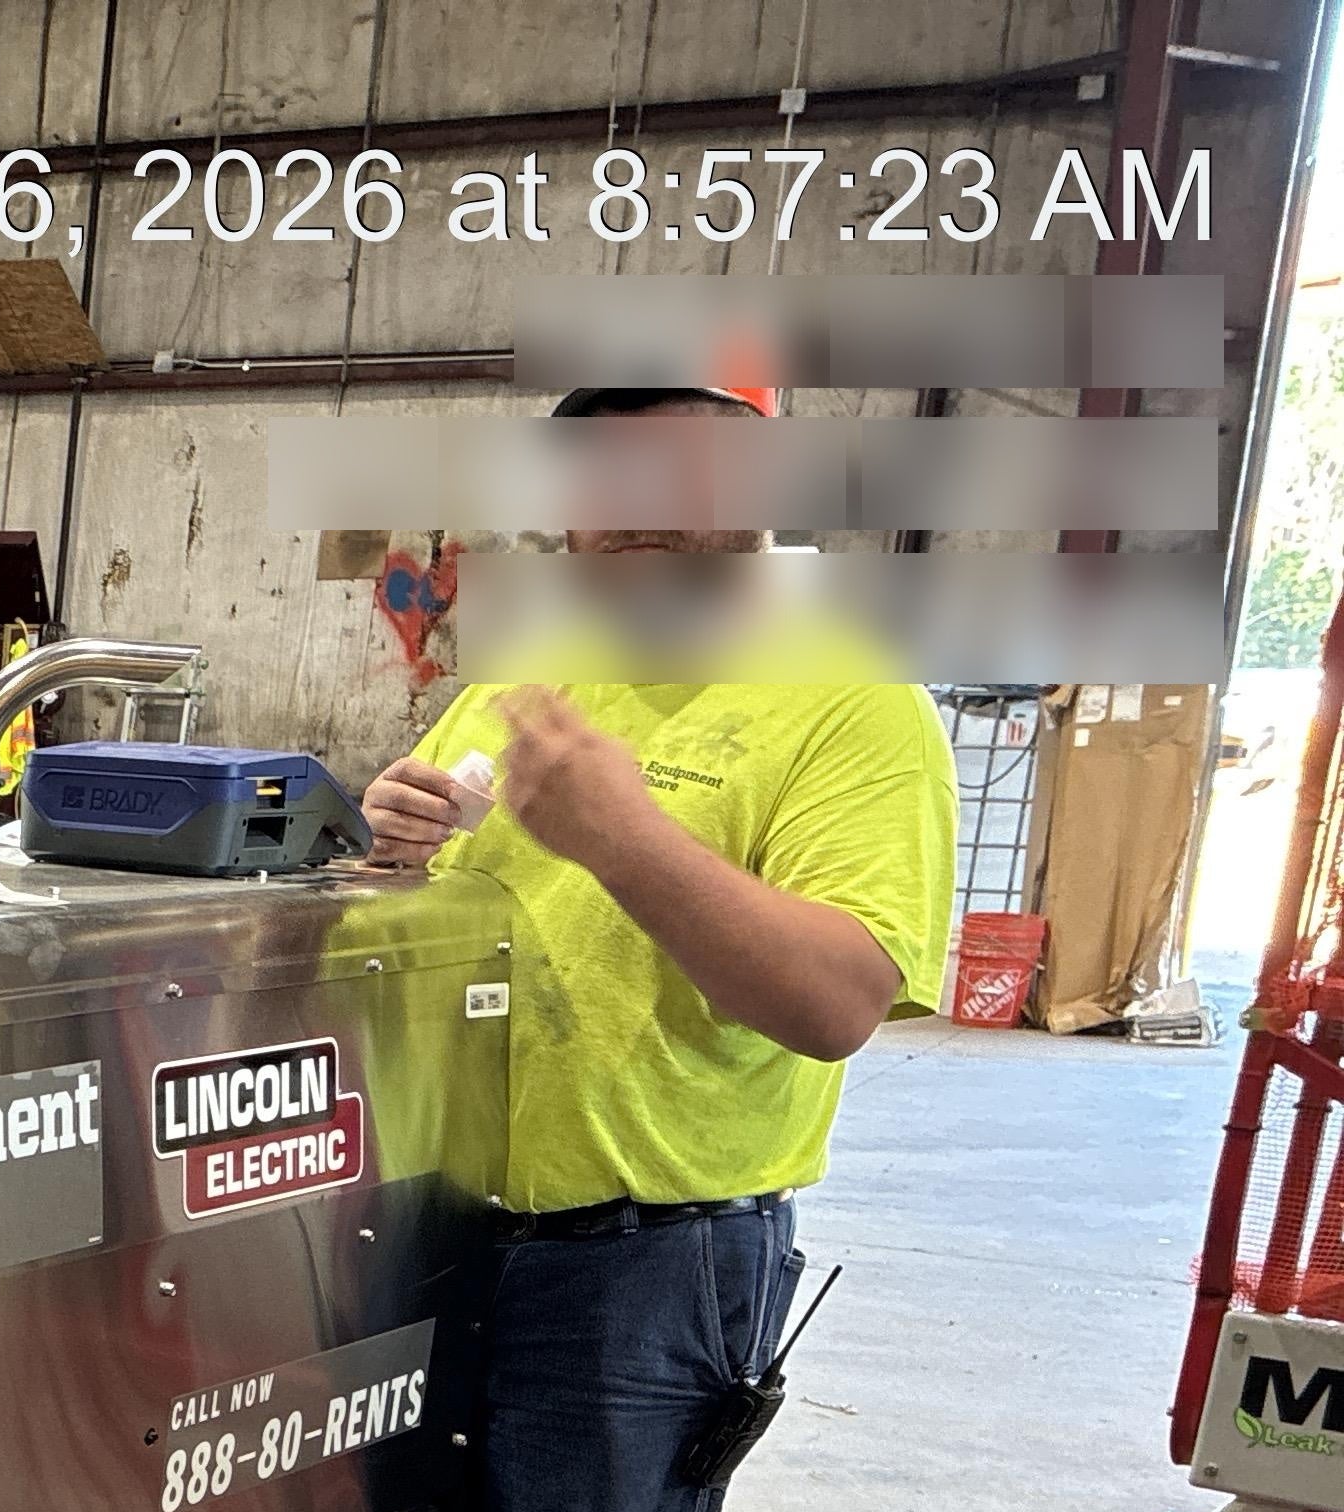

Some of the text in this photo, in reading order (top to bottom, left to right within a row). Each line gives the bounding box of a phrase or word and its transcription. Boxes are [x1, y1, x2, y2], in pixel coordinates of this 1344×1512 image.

[645, 760, 724, 790] Equipment
[89, 787, 163, 816] BRADY
[165, 1055, 328, 1141] LINCOLN
[206, 1128, 346, 1199] ELECTRIC
[171, 1372, 275, 1431] CALL NOW
[1263, 1425, 1334, 1456] Leak
